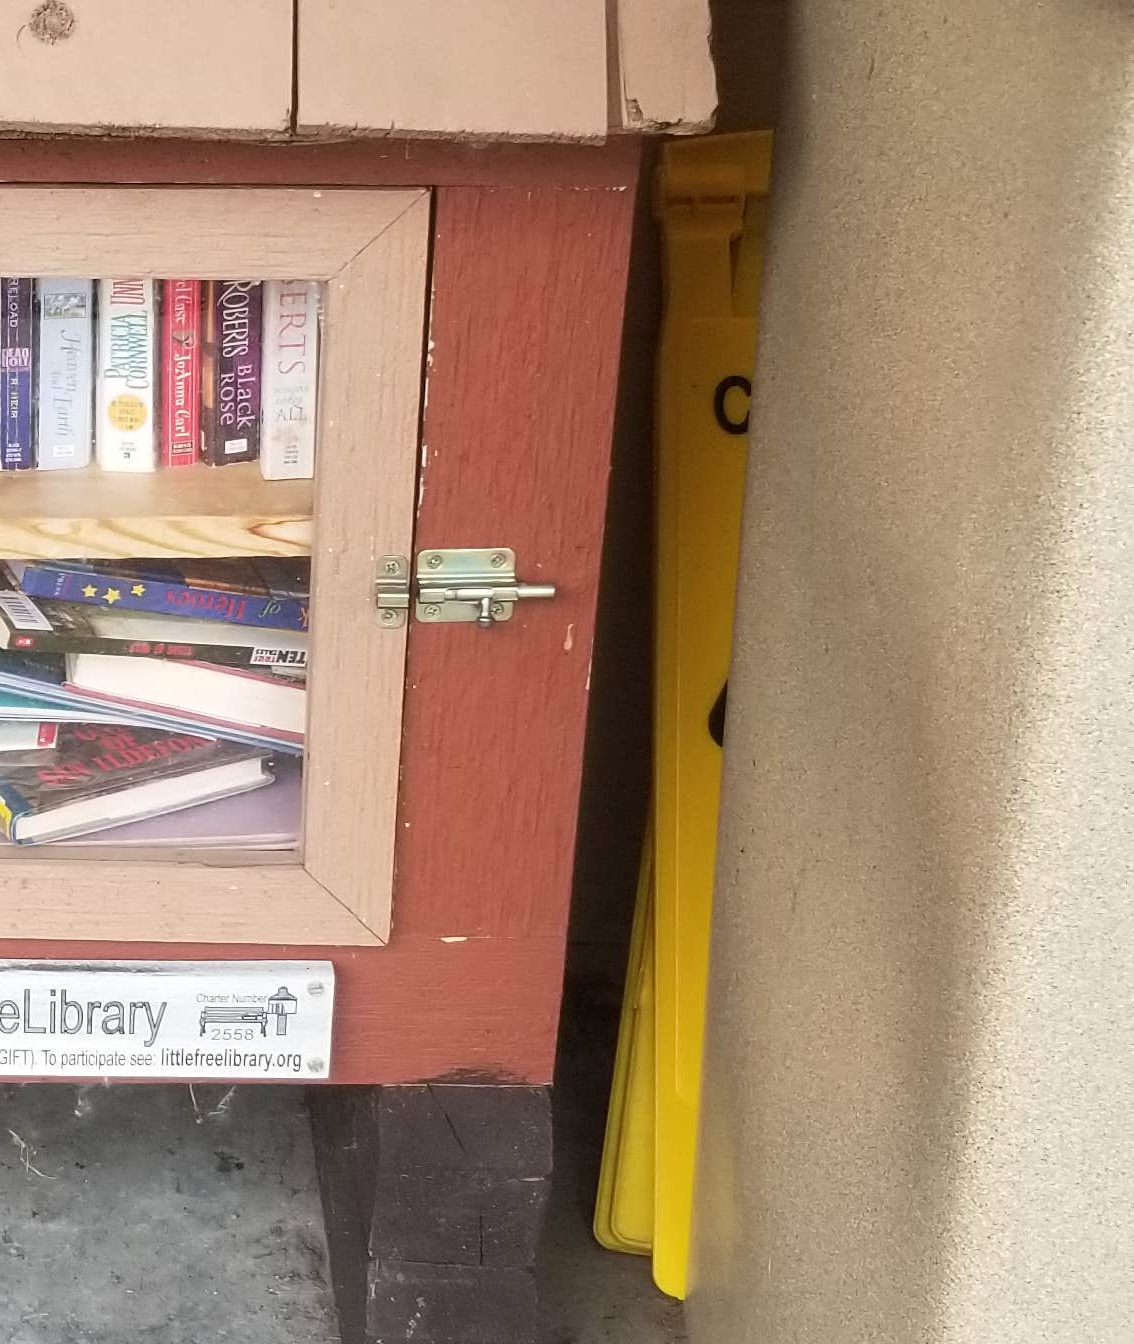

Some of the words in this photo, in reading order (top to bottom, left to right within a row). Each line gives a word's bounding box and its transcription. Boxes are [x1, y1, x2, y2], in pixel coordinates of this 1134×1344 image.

[104, 314, 131, 379] PATRICIA
[125, 310, 150, 390] CORNWELL
[276, 649, 306, 664] TEN
[196, 993, 228, 1004] Charter
[232, 993, 267, 1004] Number
[211, 1028, 254, 1041] 2558
[42, 1049, 57, 1066] To
[61, 1049, 126, 1070] participate
[160, 1048, 302, 1072] littlefreelibrary.org
